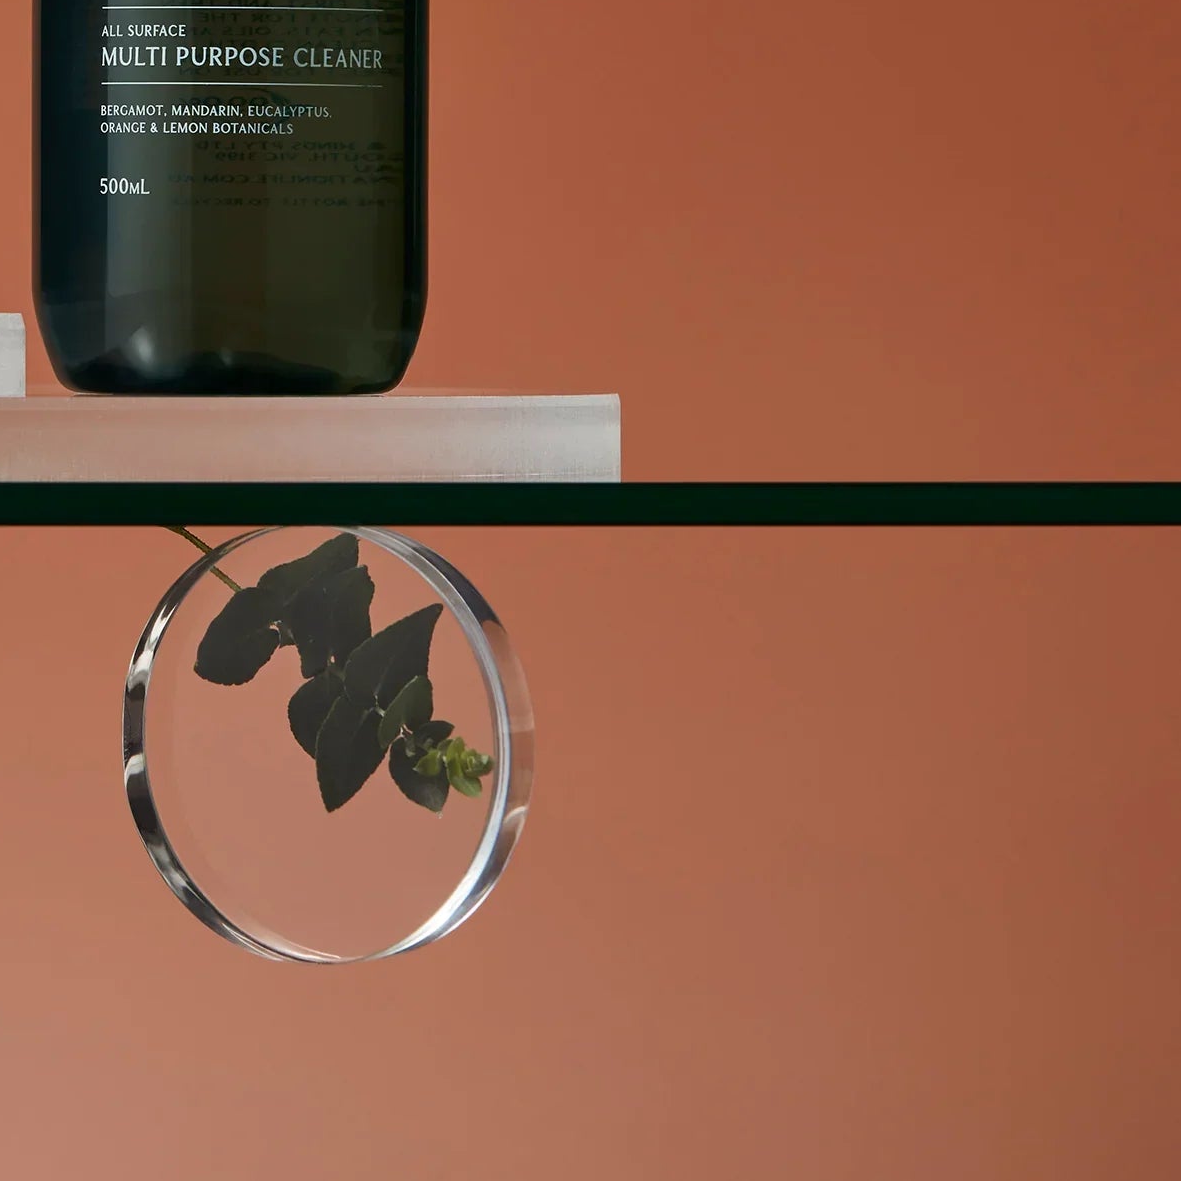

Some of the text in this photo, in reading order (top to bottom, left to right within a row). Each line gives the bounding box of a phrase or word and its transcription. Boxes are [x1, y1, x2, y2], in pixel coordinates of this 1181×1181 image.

[102, 25, 186, 37] ALL SURFACE
[102, 47, 382, 69] MULTI PURPOSE CLEANER
[100, 105, 167, 117] BERGAMOT,
[172, 105, 243, 118] MANDARIN,
[100, 123, 293, 135] ORANGE & LEMON BOTANICALS
